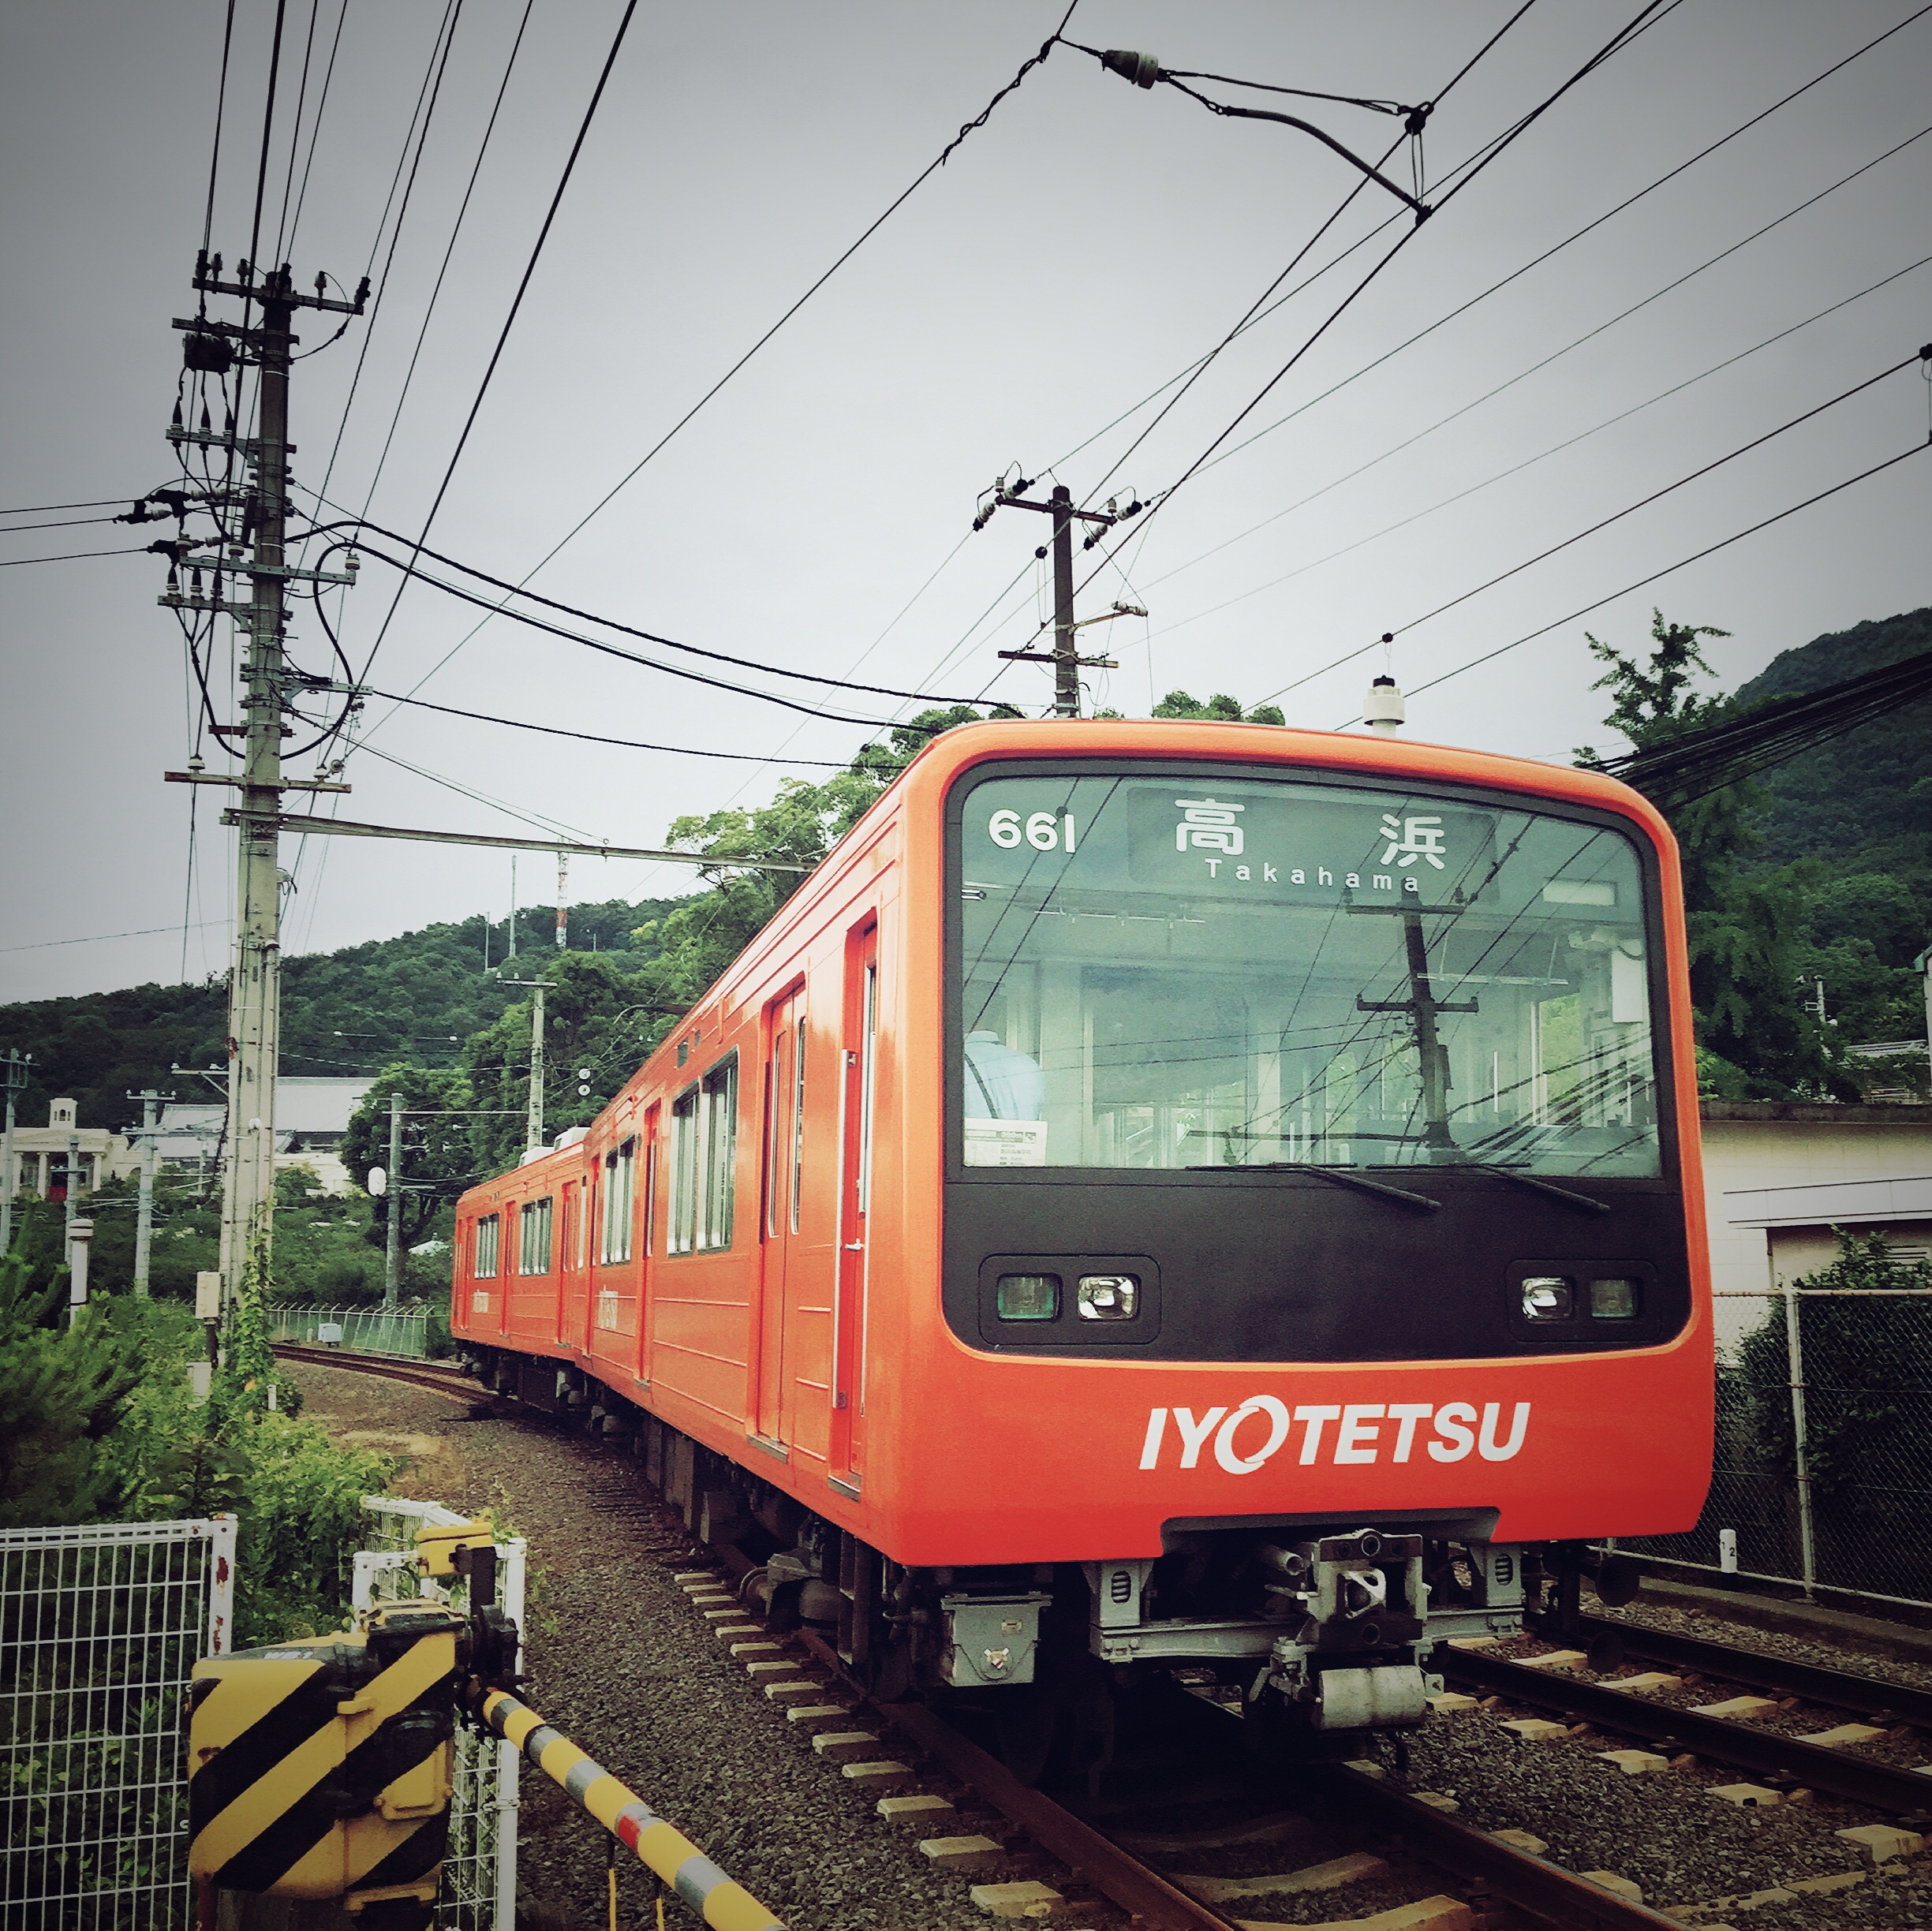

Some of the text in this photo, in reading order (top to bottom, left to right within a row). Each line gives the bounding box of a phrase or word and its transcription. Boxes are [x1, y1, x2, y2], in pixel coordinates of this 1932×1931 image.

[988, 809, 1076, 853] 661
[1175, 797, 1446, 870] 高浜
[1205, 857, 1418, 892] Takahama
[1138, 1394, 1531, 1475] IYOTETSU
[1729, 1547, 1736, 1557] 2
